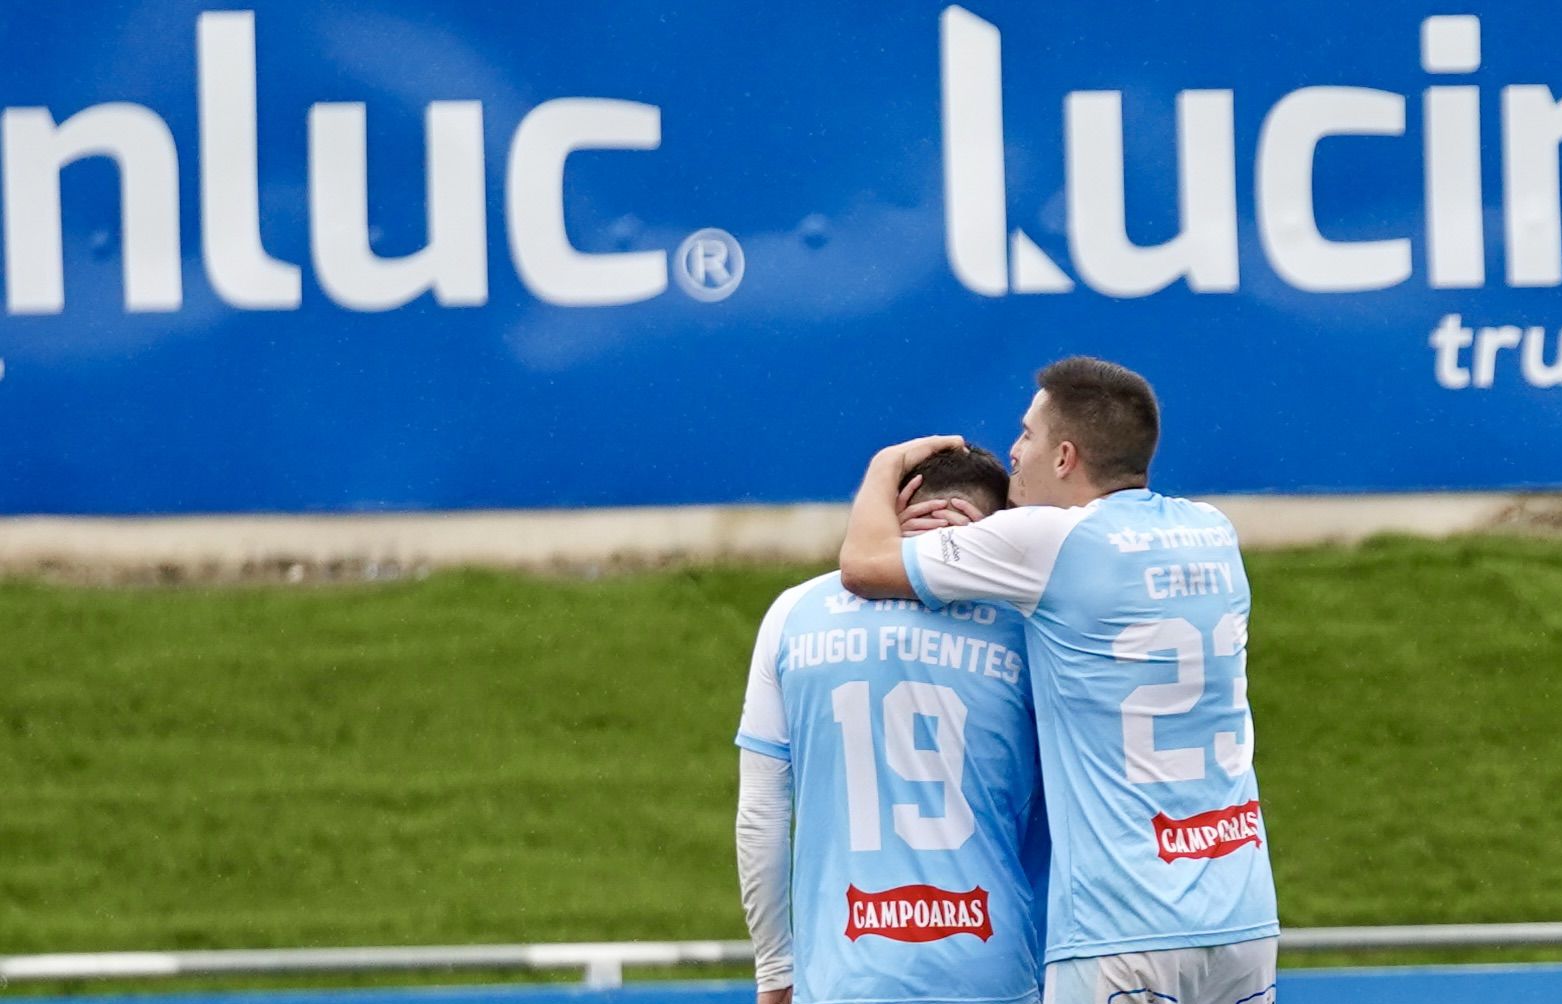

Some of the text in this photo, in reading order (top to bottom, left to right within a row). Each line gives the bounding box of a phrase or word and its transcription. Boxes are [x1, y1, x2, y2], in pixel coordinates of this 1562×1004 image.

[788, 626, 1023, 685] HUGO FUENTES
[1112, 613, 1255, 784] 23
[832, 681, 975, 852] 19
[853, 898, 984, 931] CAMPOARAS
